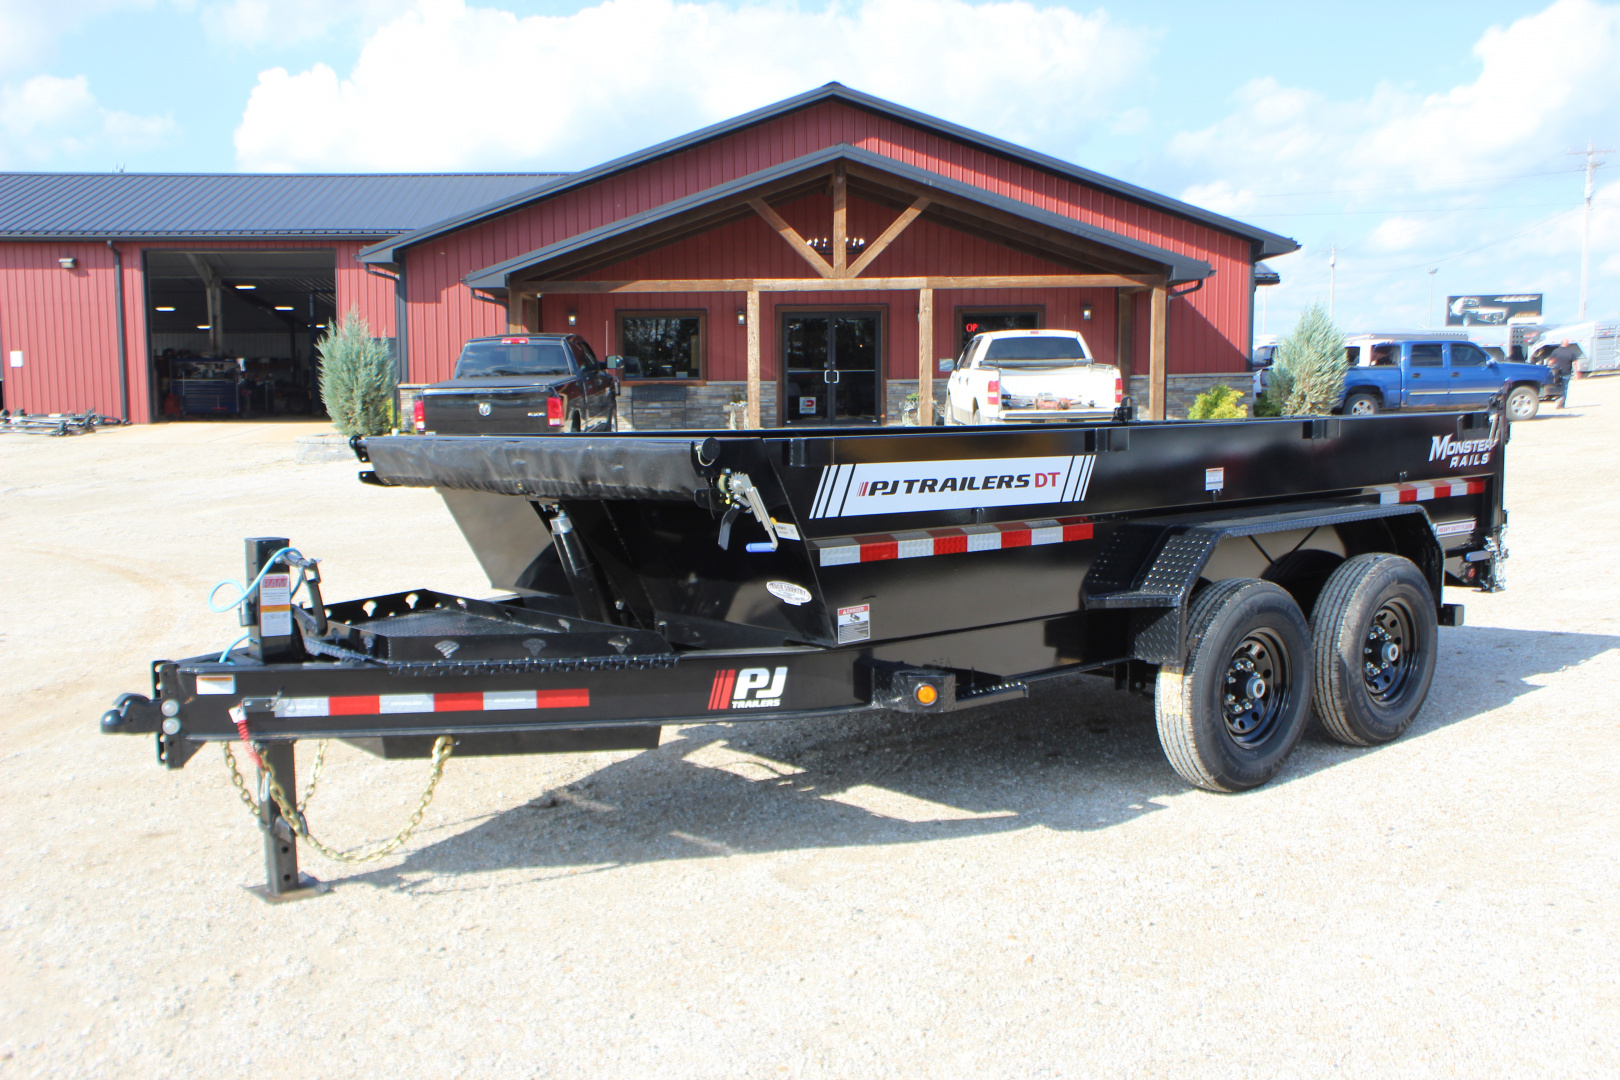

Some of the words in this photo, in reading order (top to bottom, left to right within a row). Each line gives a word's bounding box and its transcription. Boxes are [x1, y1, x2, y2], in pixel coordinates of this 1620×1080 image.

[1449, 452, 1491, 468] RAILS
[868, 479, 900, 496] PJ
[903, 474, 1031, 494] TRAILERS
[1034, 472, 1061, 488] DT
[262, 579, 288, 589] RAM
[846, 606, 865, 614] DANGER
[733, 666, 788, 700] PJ
[732, 698, 781, 709] TRAILERS
